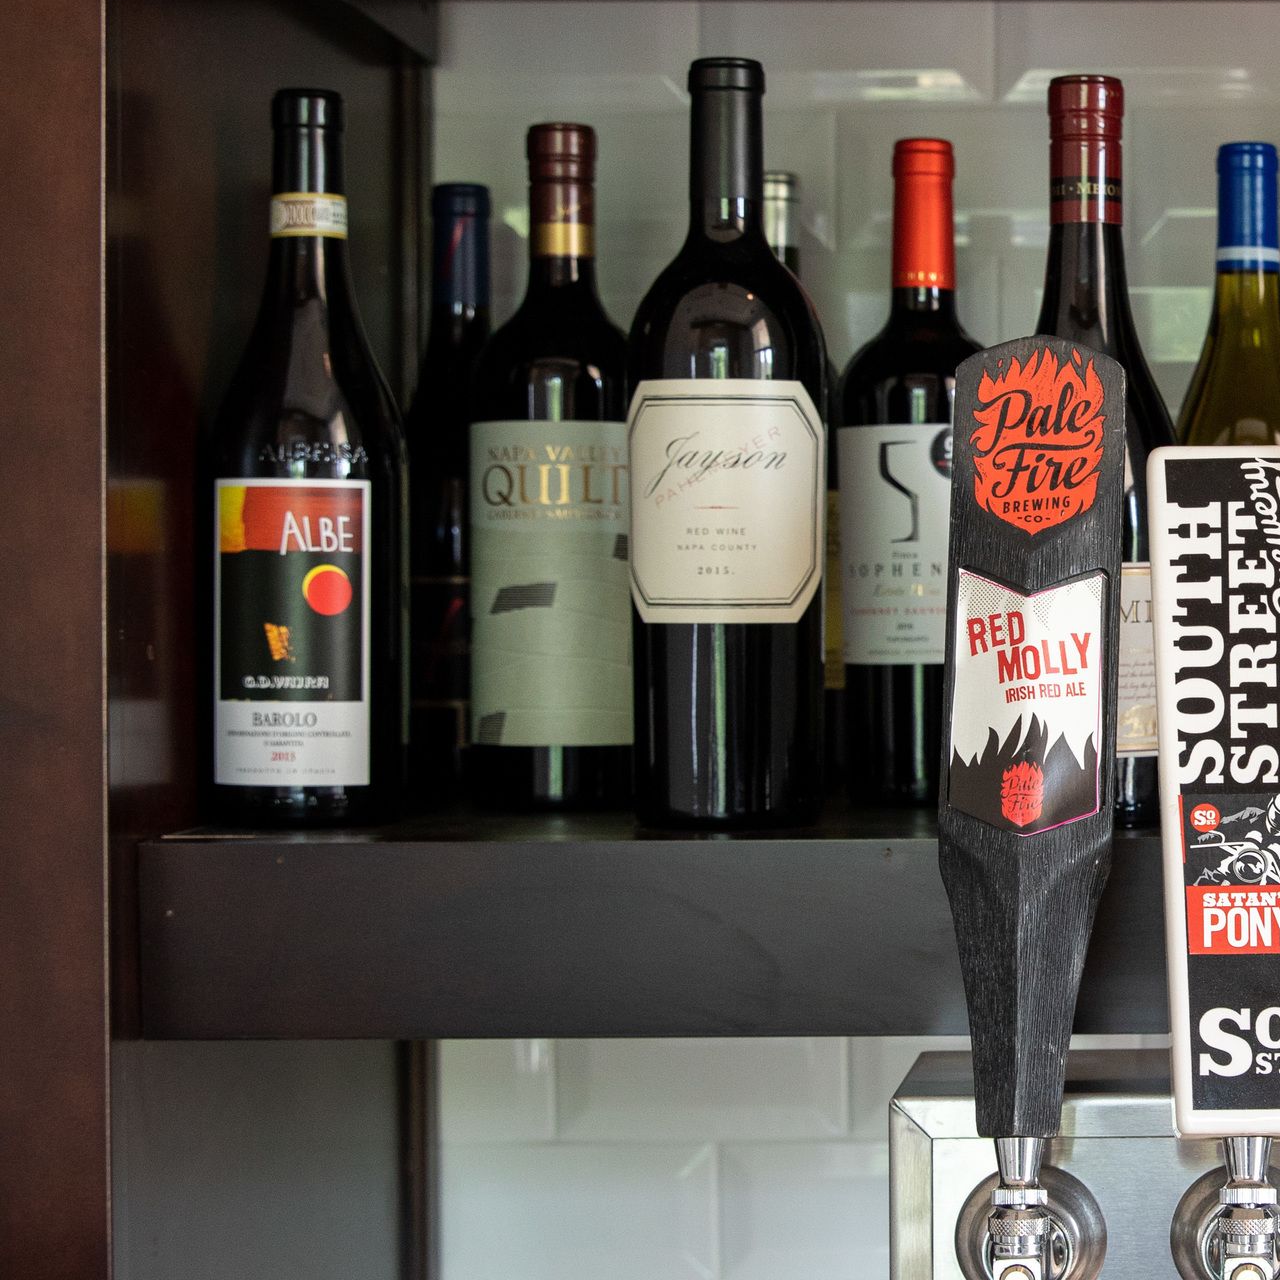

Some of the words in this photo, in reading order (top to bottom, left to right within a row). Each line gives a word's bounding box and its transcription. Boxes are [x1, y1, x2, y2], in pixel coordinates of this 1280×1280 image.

[974, 381, 1095, 457] Pale
[482, 463, 628, 507] QUILT
[645, 431, 788, 499] Jayson
[991, 431, 1098, 498] Fire
[1003, 495, 1071, 514] BREWING
[279, 510, 355, 556] ALBE
[686, 527, 710, 536] RED
[715, 527, 747, 536] WINE
[966, 610, 1026, 658] RED
[996, 632, 1092, 684] MOLLY
[1167, 500, 1226, 785] SOUTH
[1227, 500, 1280, 785] STREET
[1004, 684, 1036, 704] IRISH
[1039, 682, 1062, 699] RED
[1065, 681, 1087, 698] ALE
[251, 712, 318, 728] BAROLO
